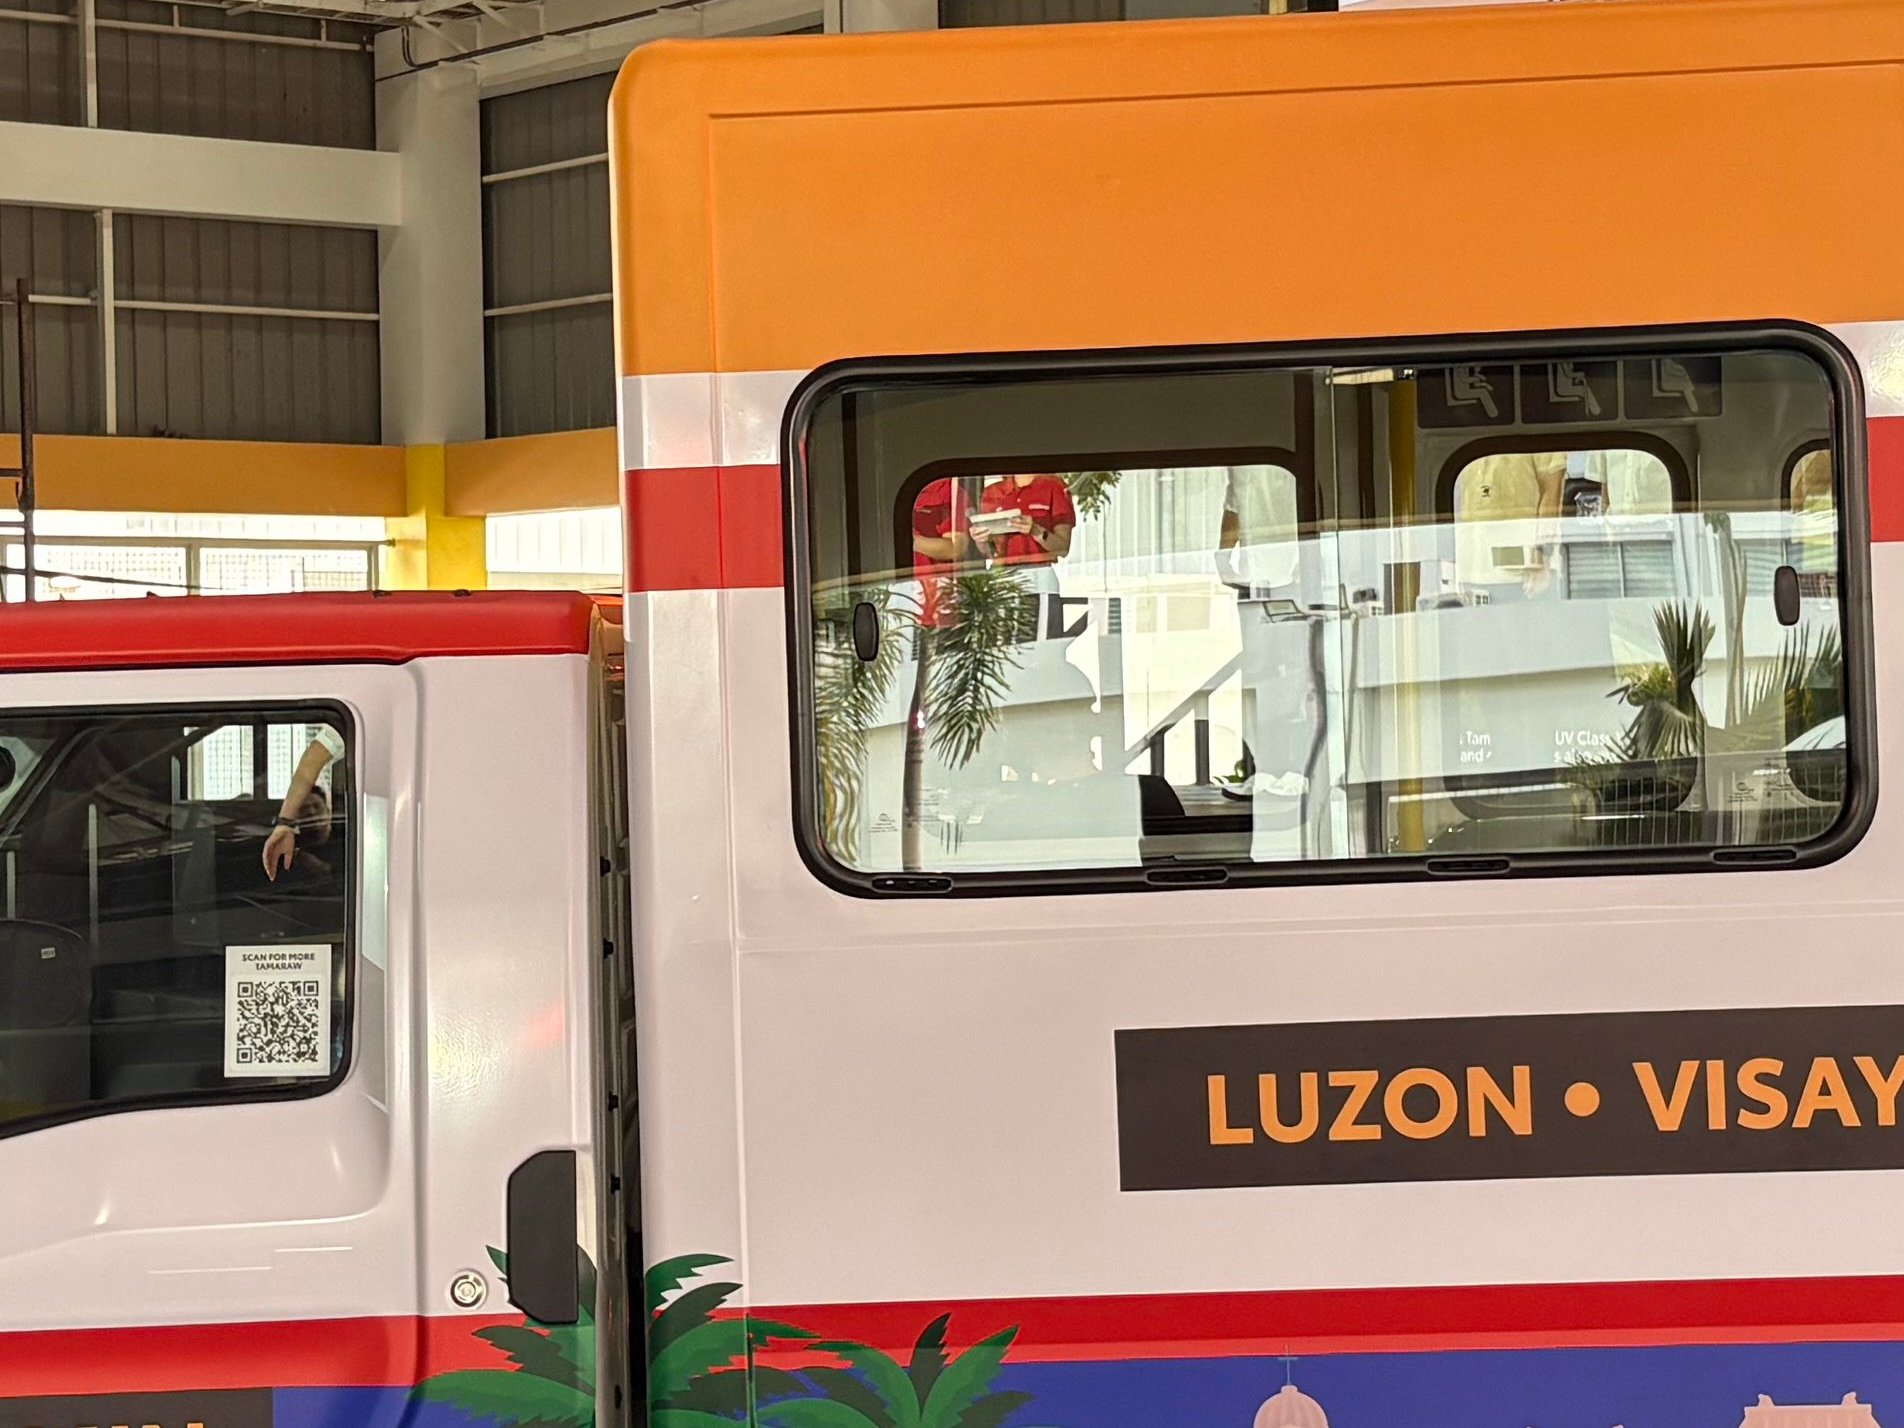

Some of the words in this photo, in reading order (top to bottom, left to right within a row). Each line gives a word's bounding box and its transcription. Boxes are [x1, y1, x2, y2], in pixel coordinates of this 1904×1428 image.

[1555, 730, 1574, 746] UV
[242, 953, 267, 962] SCAN
[268, 952, 287, 962] FOR
[288, 952, 315, 962] MORE
[256, 962, 302, 971] TAMARAW
[1208, 1066, 1533, 1145] LUZON
